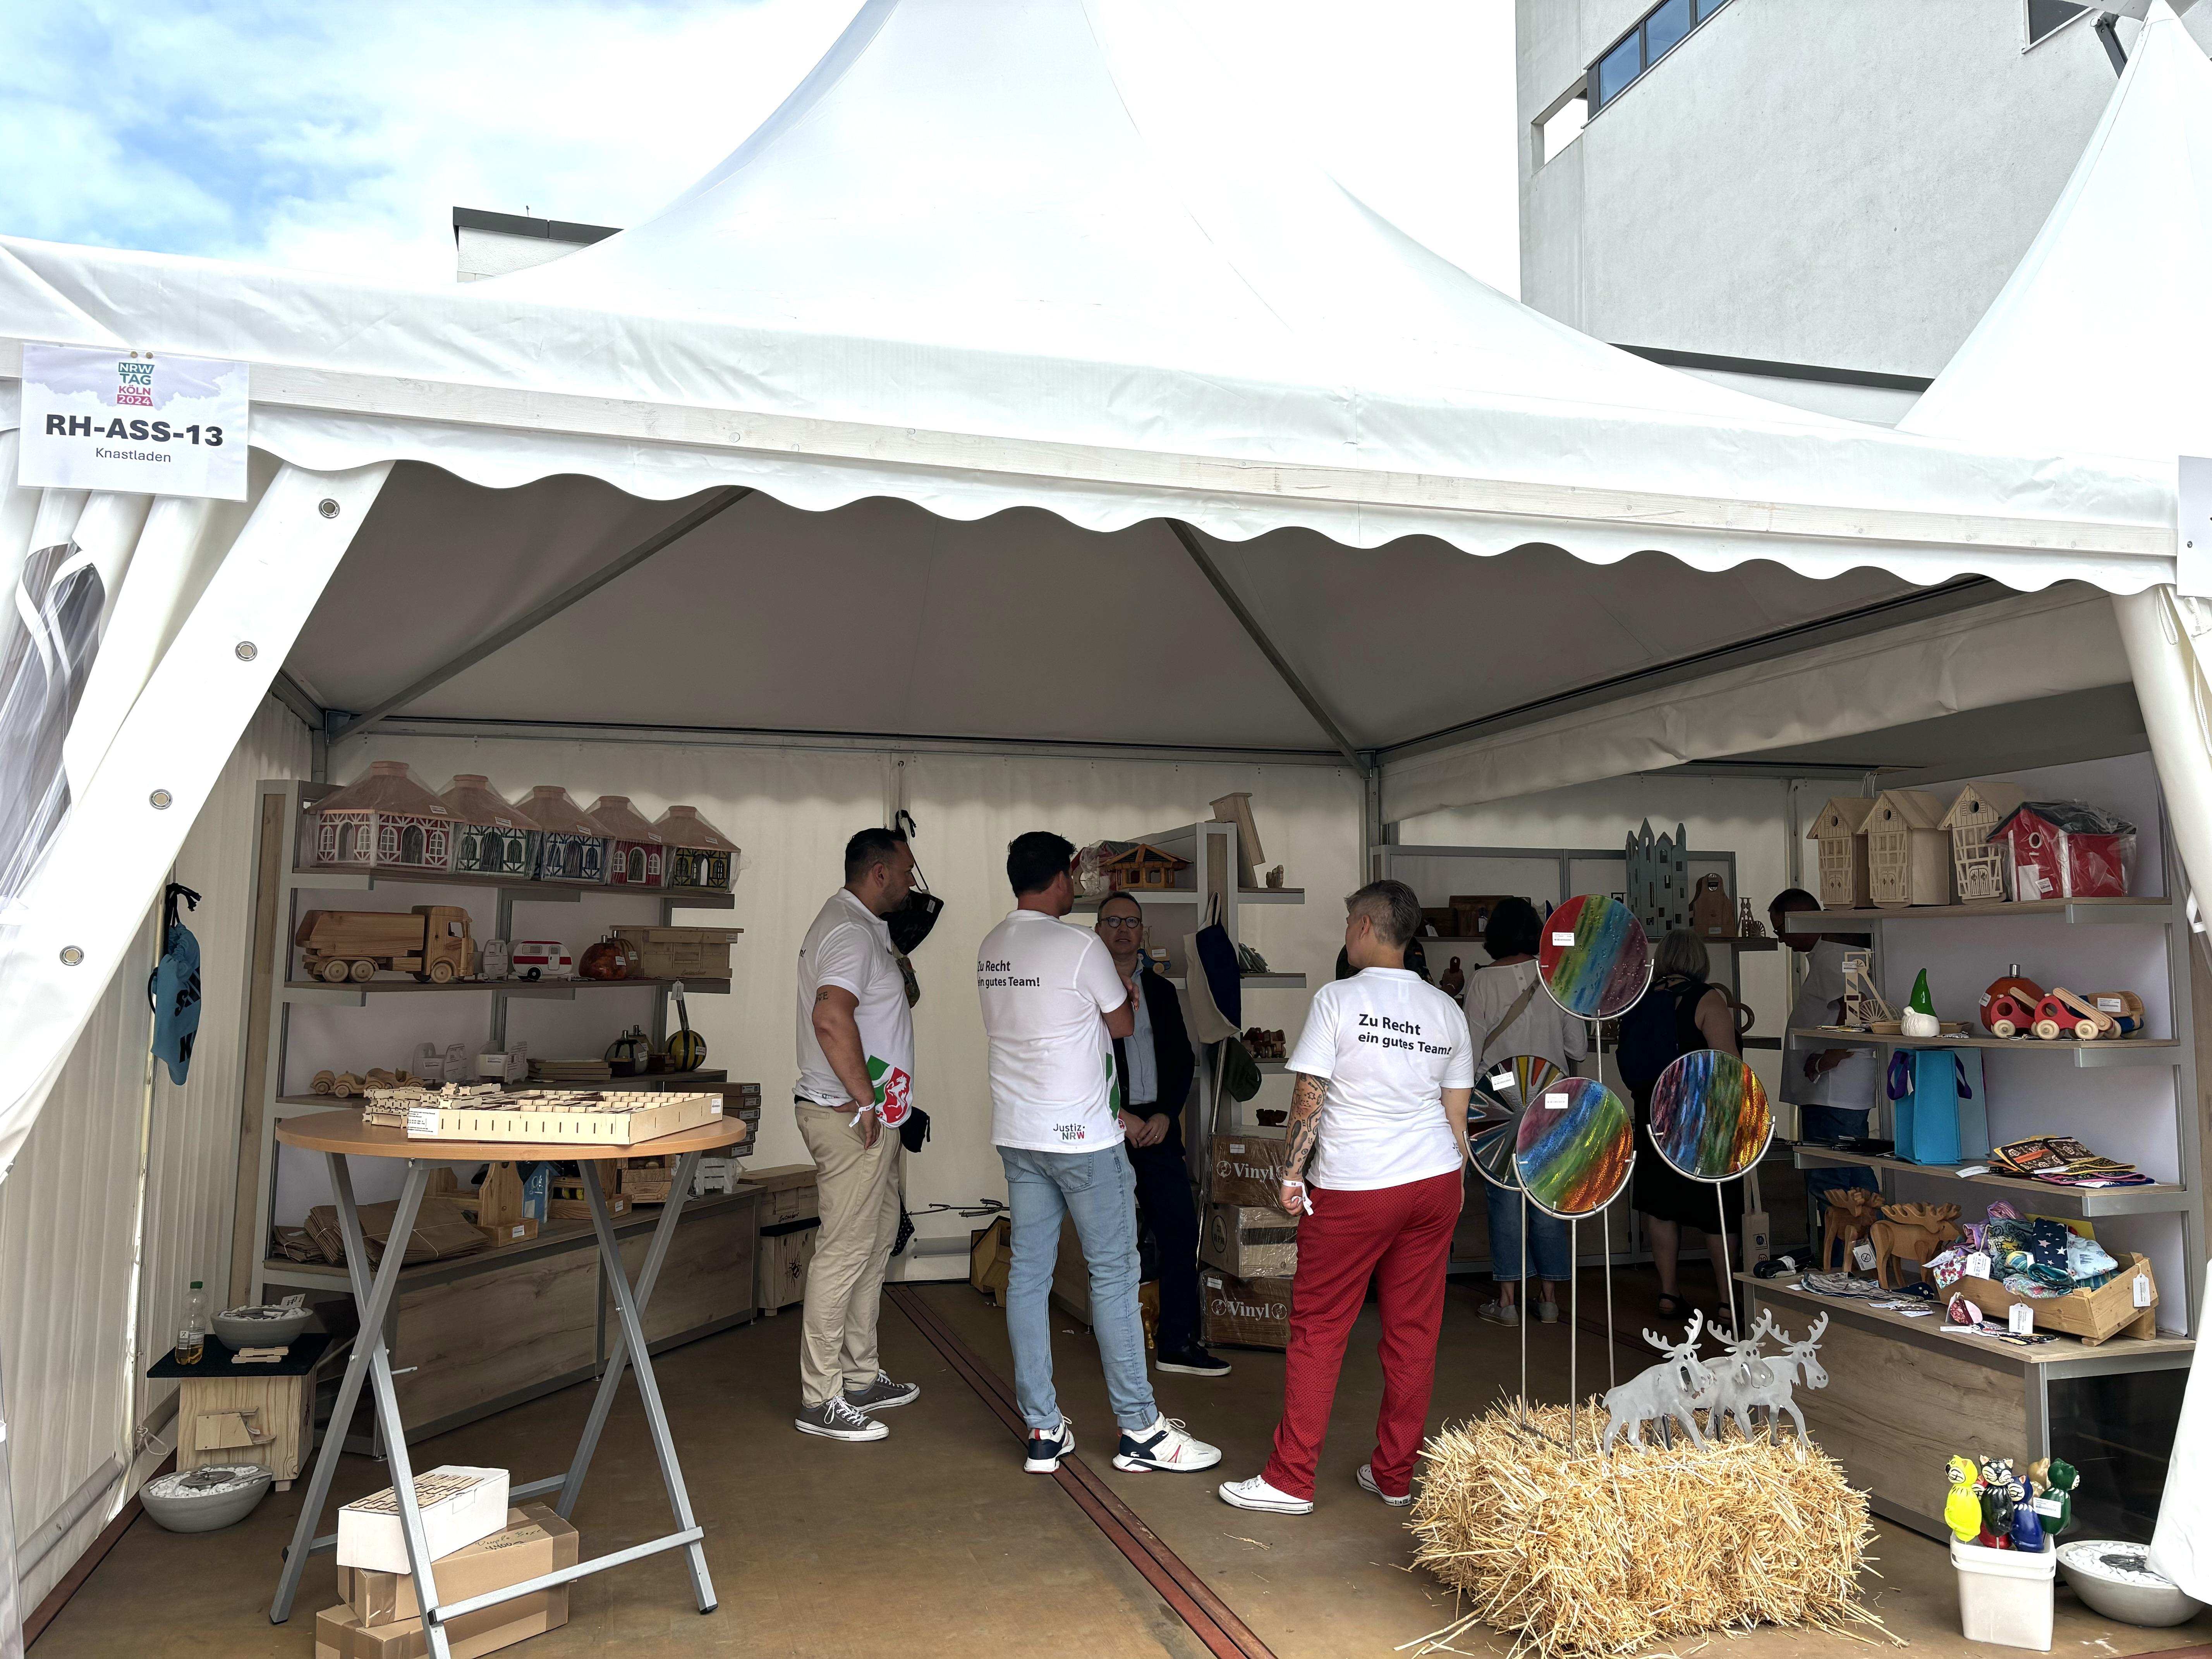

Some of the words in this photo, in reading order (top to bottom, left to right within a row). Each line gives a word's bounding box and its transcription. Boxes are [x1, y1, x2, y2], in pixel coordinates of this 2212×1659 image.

[120, 363, 152, 373] NRW
[120, 374, 151, 385] TAG
[118, 385, 151, 395] KÖLN
[119, 396, 150, 405] 2024
[46, 414, 223, 446] RH-ASS-13
[96, 448, 171, 462] Knastladen
[986, 960, 1010, 971] Recht
[986, 978, 1006, 989] gutes
[1008, 977, 1040, 987] Team!
[1358, 1014, 1378, 1027] Zu
[1382, 1017, 1421, 1036] Recht
[1358, 1032, 1378, 1043] ein
[1382, 1037, 1414, 1050] gutes
[1418, 1041, 1452, 1055] Team!
[1062, 1131, 1084, 1140] NRW
[1233, 1163, 1273, 1182] Vinyl
[1228, 1301, 1269, 1321] Vinyl
